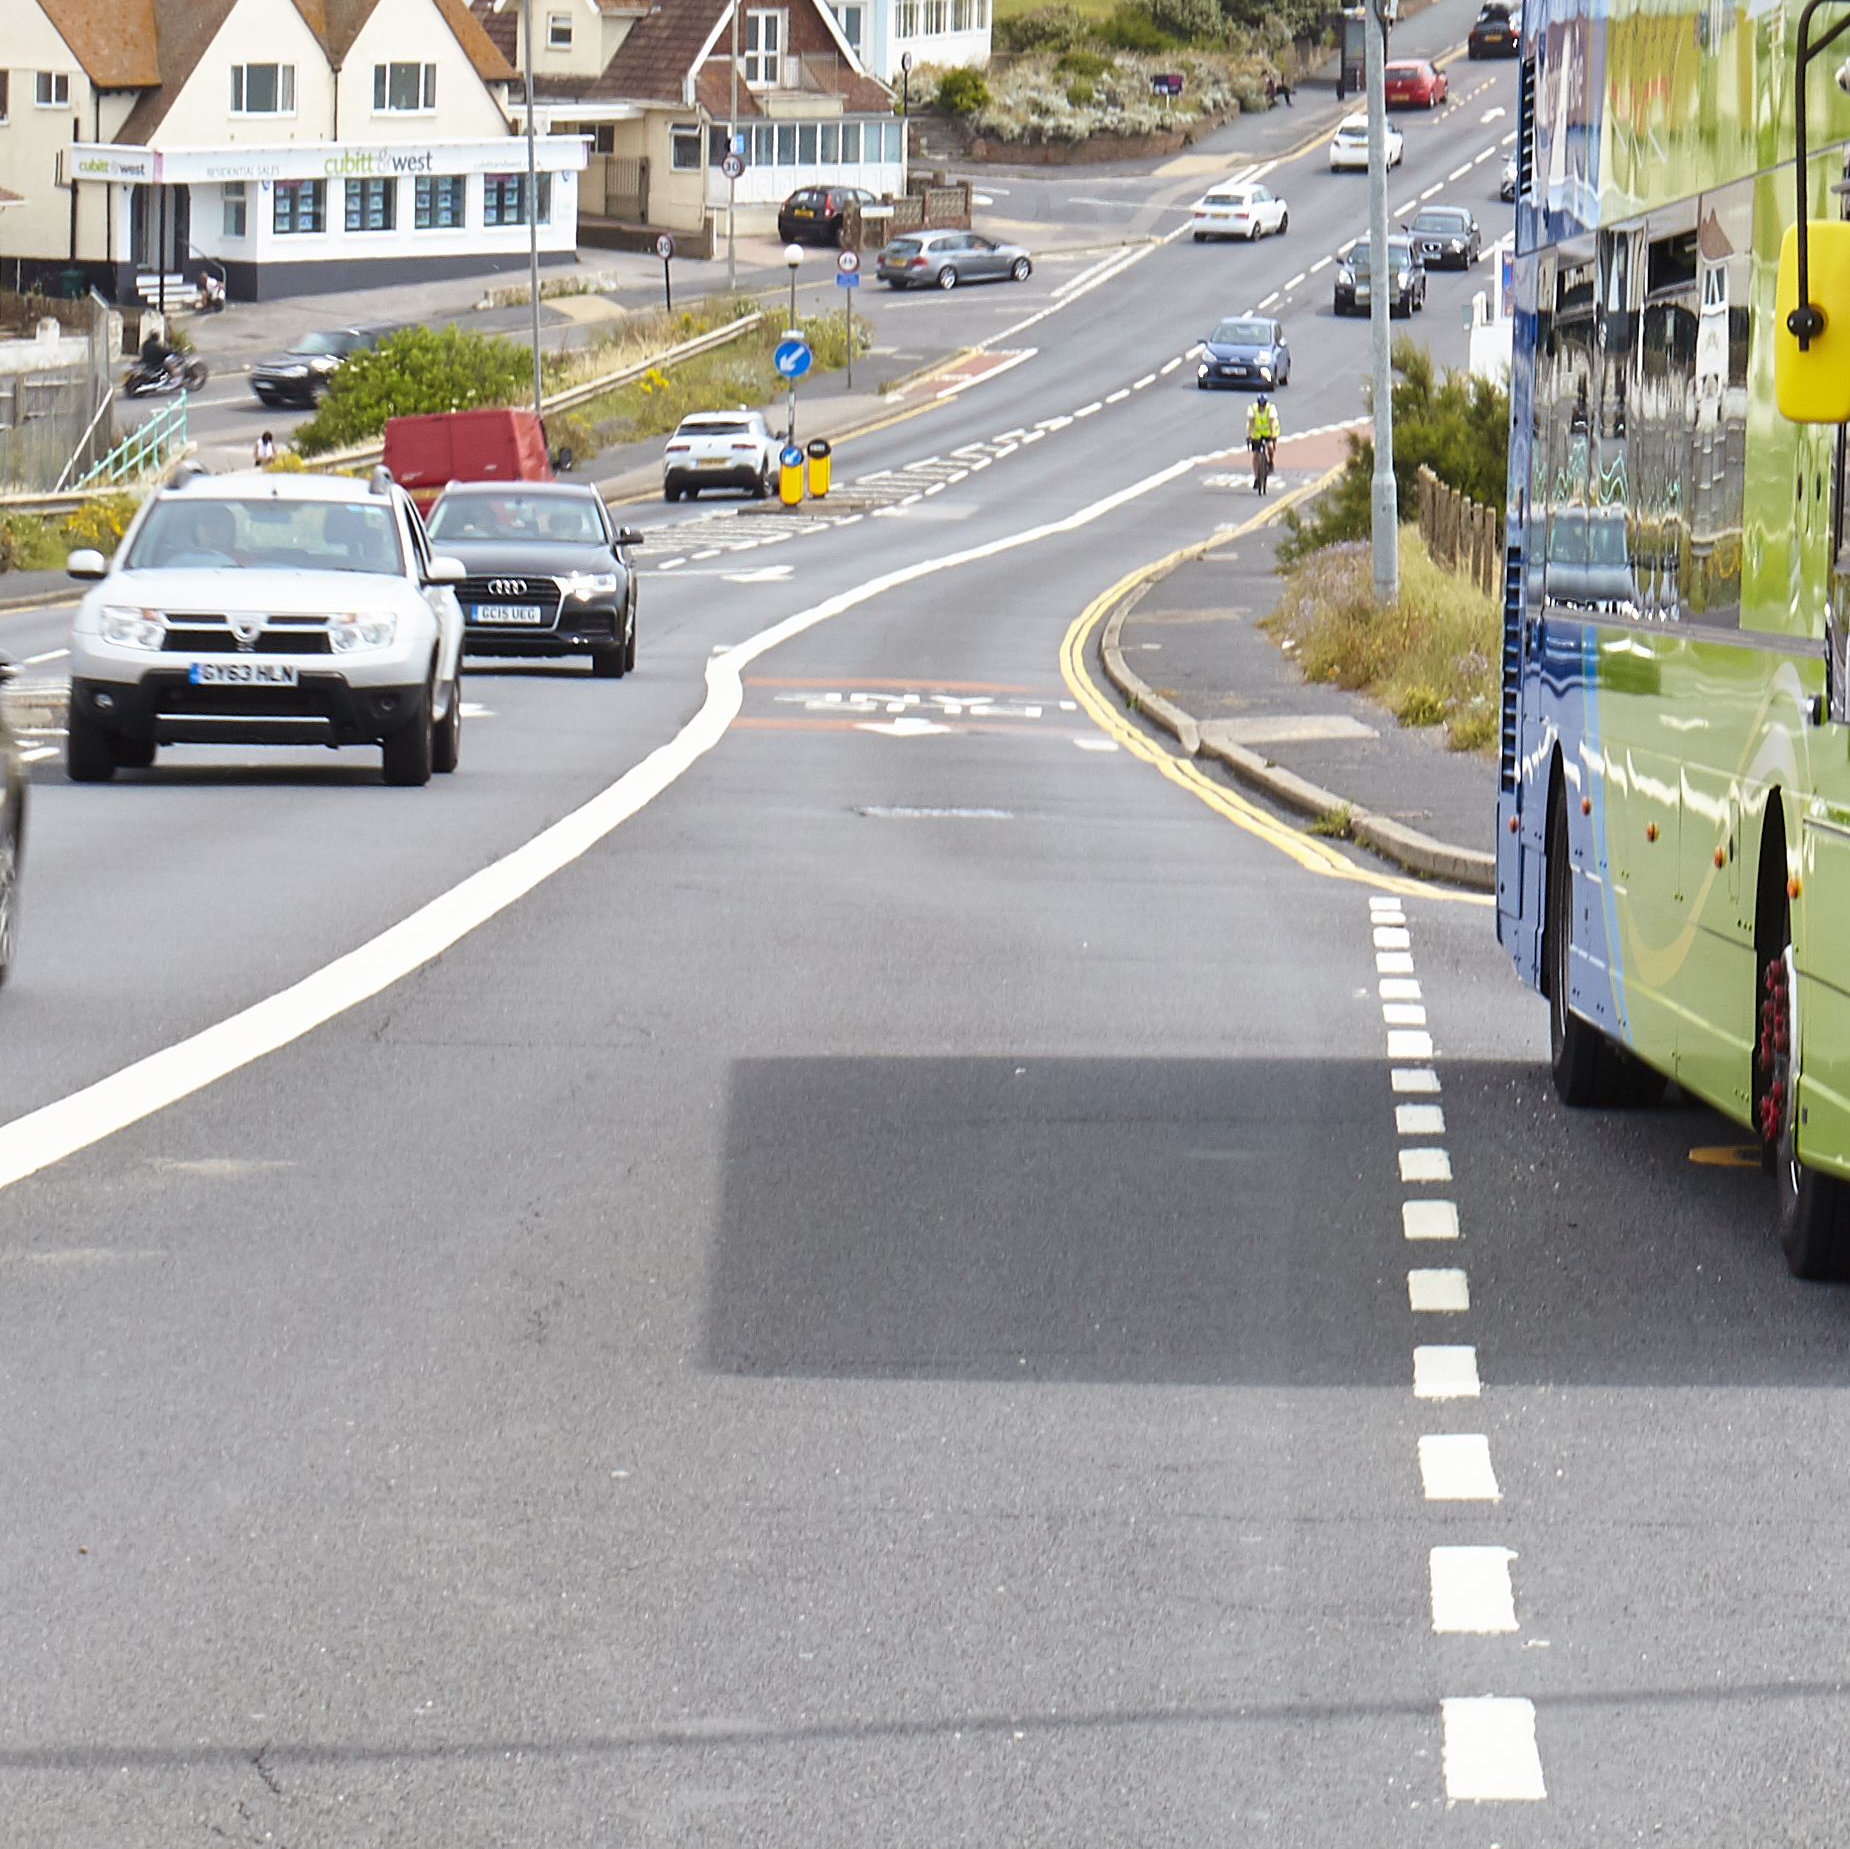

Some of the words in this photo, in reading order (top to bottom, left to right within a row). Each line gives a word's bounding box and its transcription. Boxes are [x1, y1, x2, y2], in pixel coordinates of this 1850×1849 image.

[324, 149, 374, 174] cubitt
[391, 151, 433, 172] west
[206, 166, 255, 177] RESIDENTIAL
[256, 165, 280, 176] SALES
